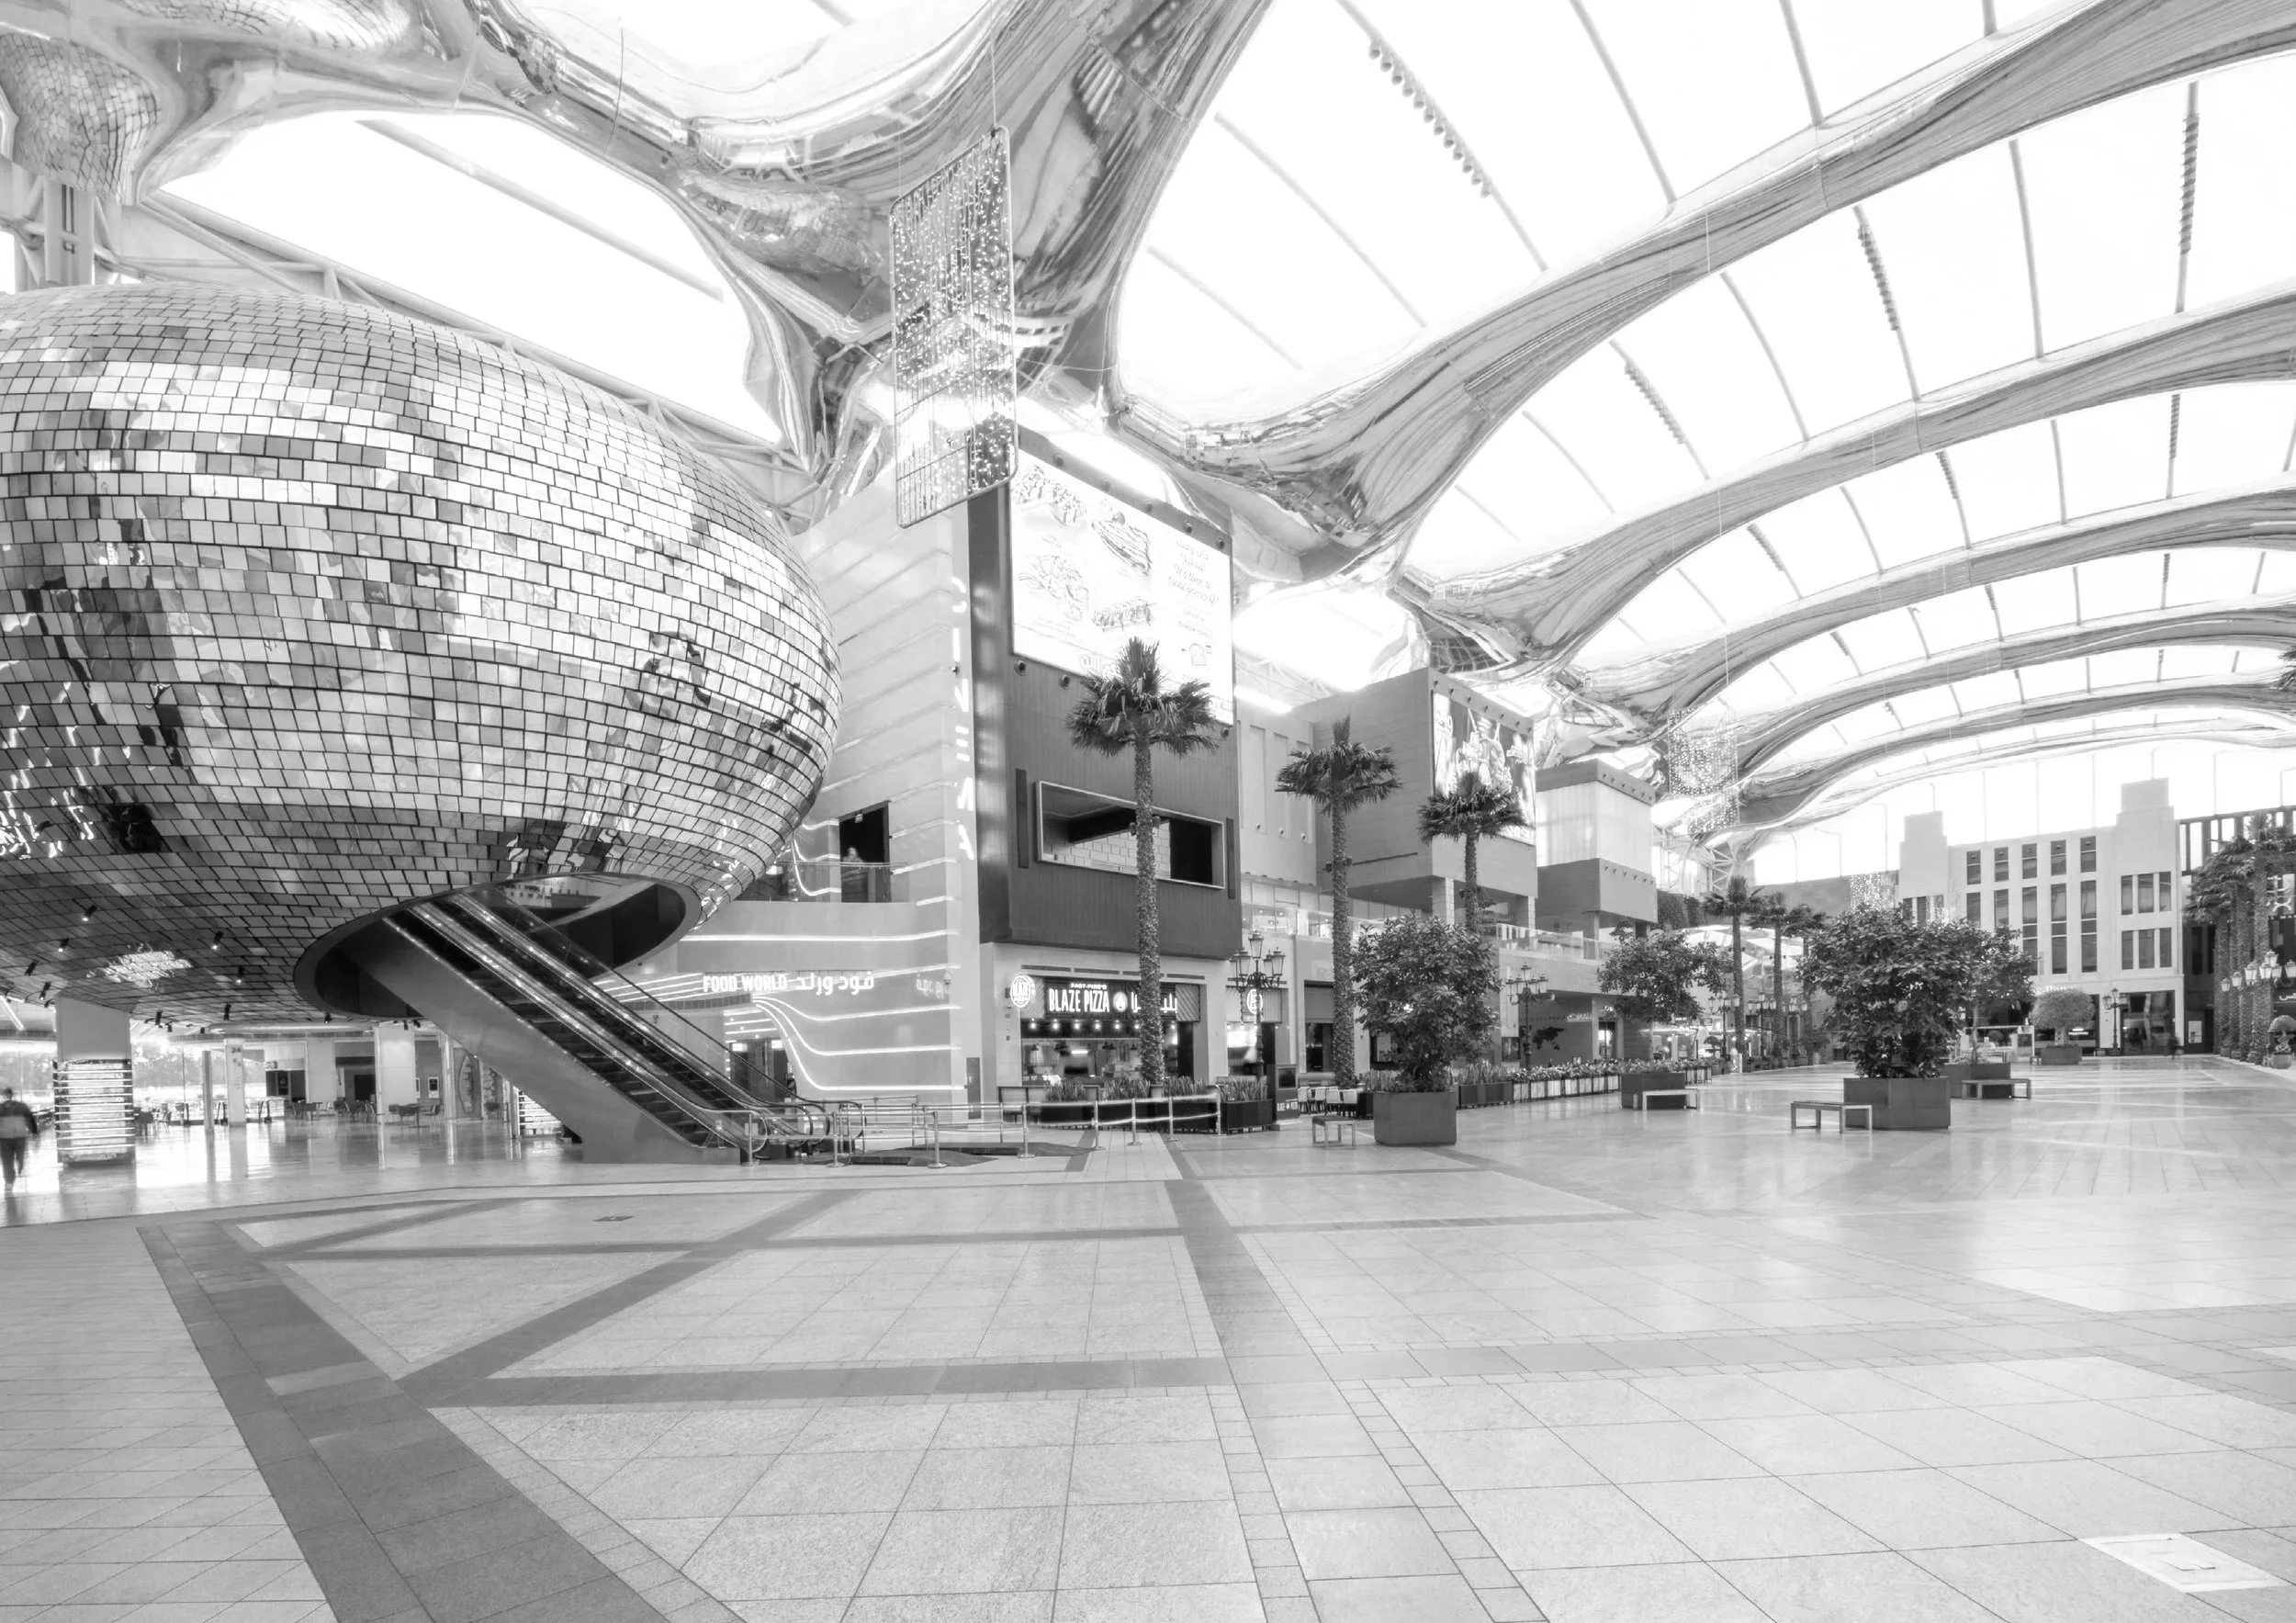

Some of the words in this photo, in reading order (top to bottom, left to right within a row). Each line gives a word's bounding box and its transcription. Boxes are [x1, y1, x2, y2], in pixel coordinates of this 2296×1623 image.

[703, 975, 737, 993] FOOD
[741, 974, 787, 991] WORLD
[795, 972, 833, 996] ورلد
[838, 971, 874, 996] فود
[1048, 987, 1082, 1012] BLAZE
[1084, 988, 1110, 1013] PIZZA
